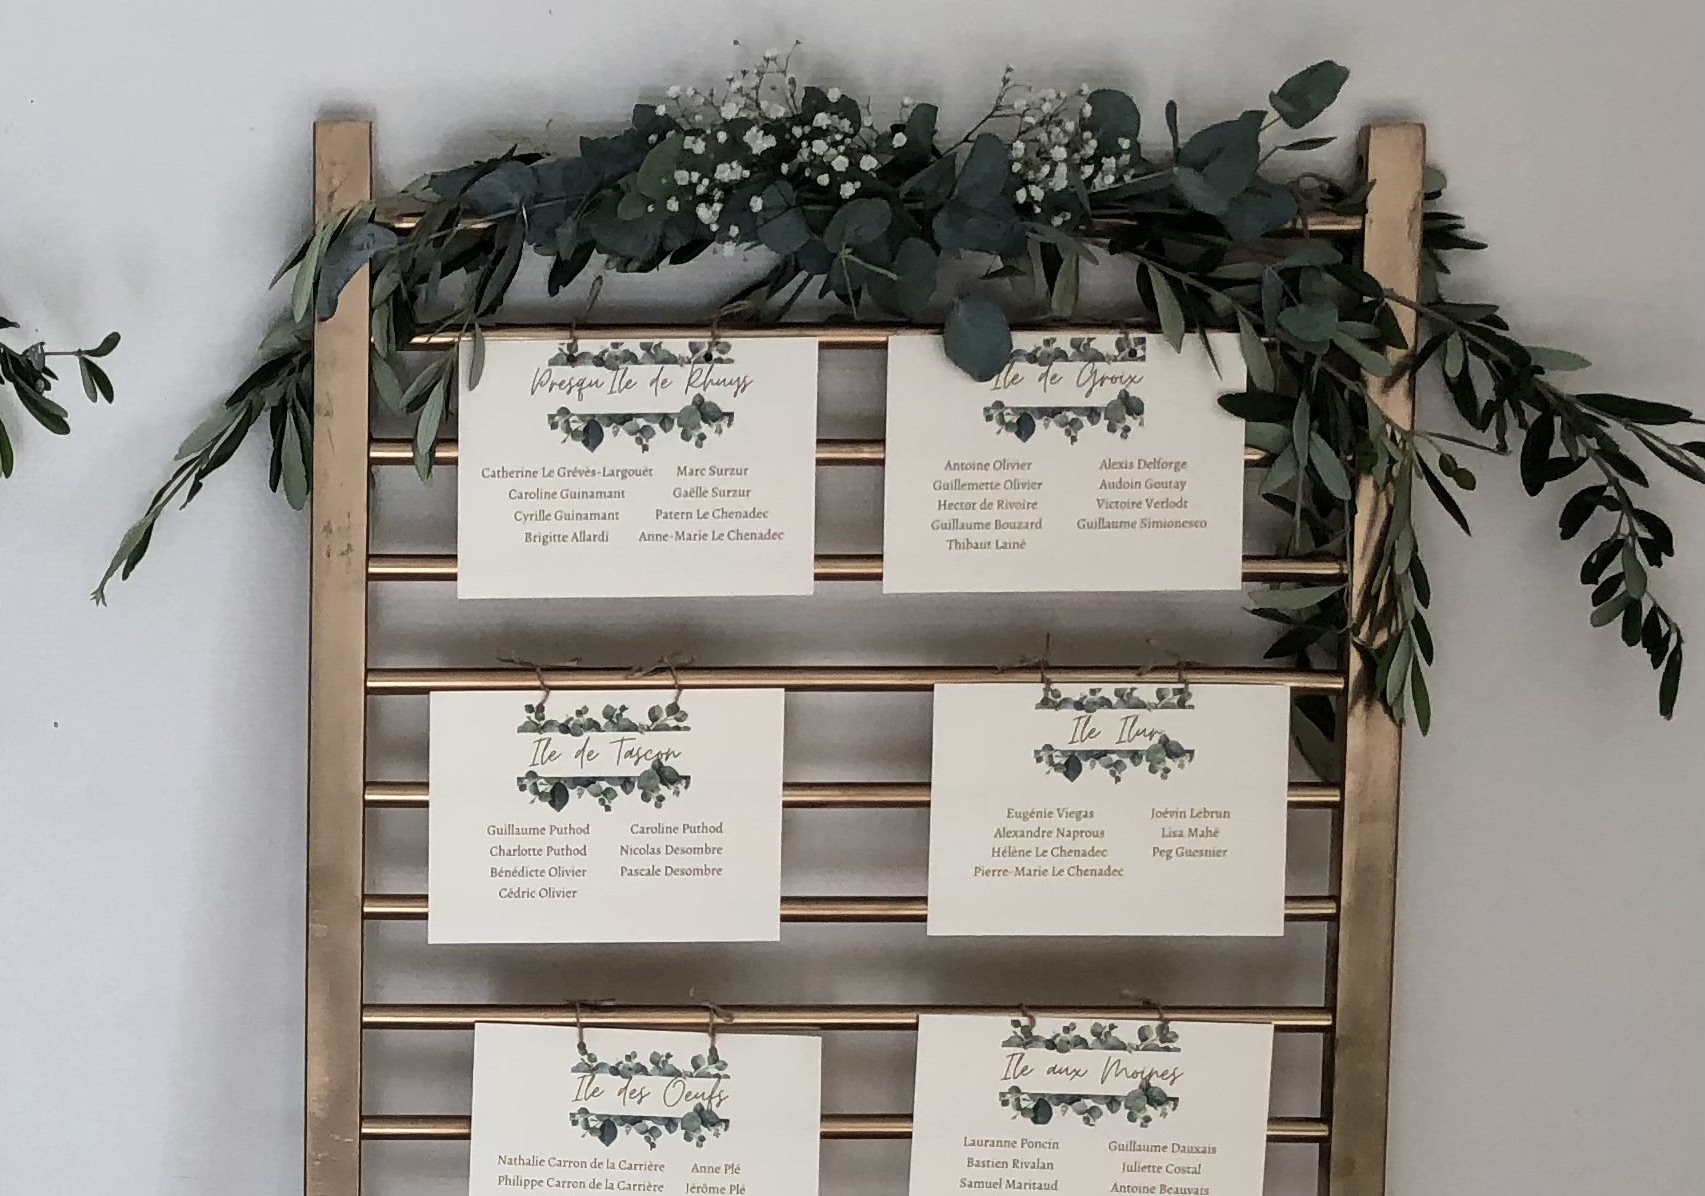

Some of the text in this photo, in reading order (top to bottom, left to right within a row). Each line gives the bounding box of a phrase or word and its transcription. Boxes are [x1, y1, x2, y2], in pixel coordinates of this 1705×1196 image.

[649, 364, 753, 399] de Rhuys
[1037, 362, 1063, 394] de
[1076, 362, 1144, 398] Groix
[676, 465, 749, 477] Marc Surzur
[944, 458, 1032, 471] Antoine Olivier
[1099, 457, 1187, 473] Alexis Delforge
[508, 487, 625, 500] Caroline Guinamant
[931, 517, 1042, 531] Guillaume Bouzard
[574, 737, 600, 769] de
[609, 737, 683, 766] Tascon
[630, 821, 724, 835] Caroline Puthod
[994, 826, 1053, 839] Alexandre
[620, 842, 723, 856] Nicolas Desombre
[991, 845, 1107, 858] Hélène Le Chenadec
[1046, 1063, 1088, 1079] aux
[1100, 1055, 1184, 1087] Moines
[617, 1076, 651, 1107] des
[498, 1154, 665, 1172] Nathalie Carron de la Carrière
[967, 1156, 1054, 1170] Bastien Rivalan
[959, 1177, 1002, 1190] Samuel
